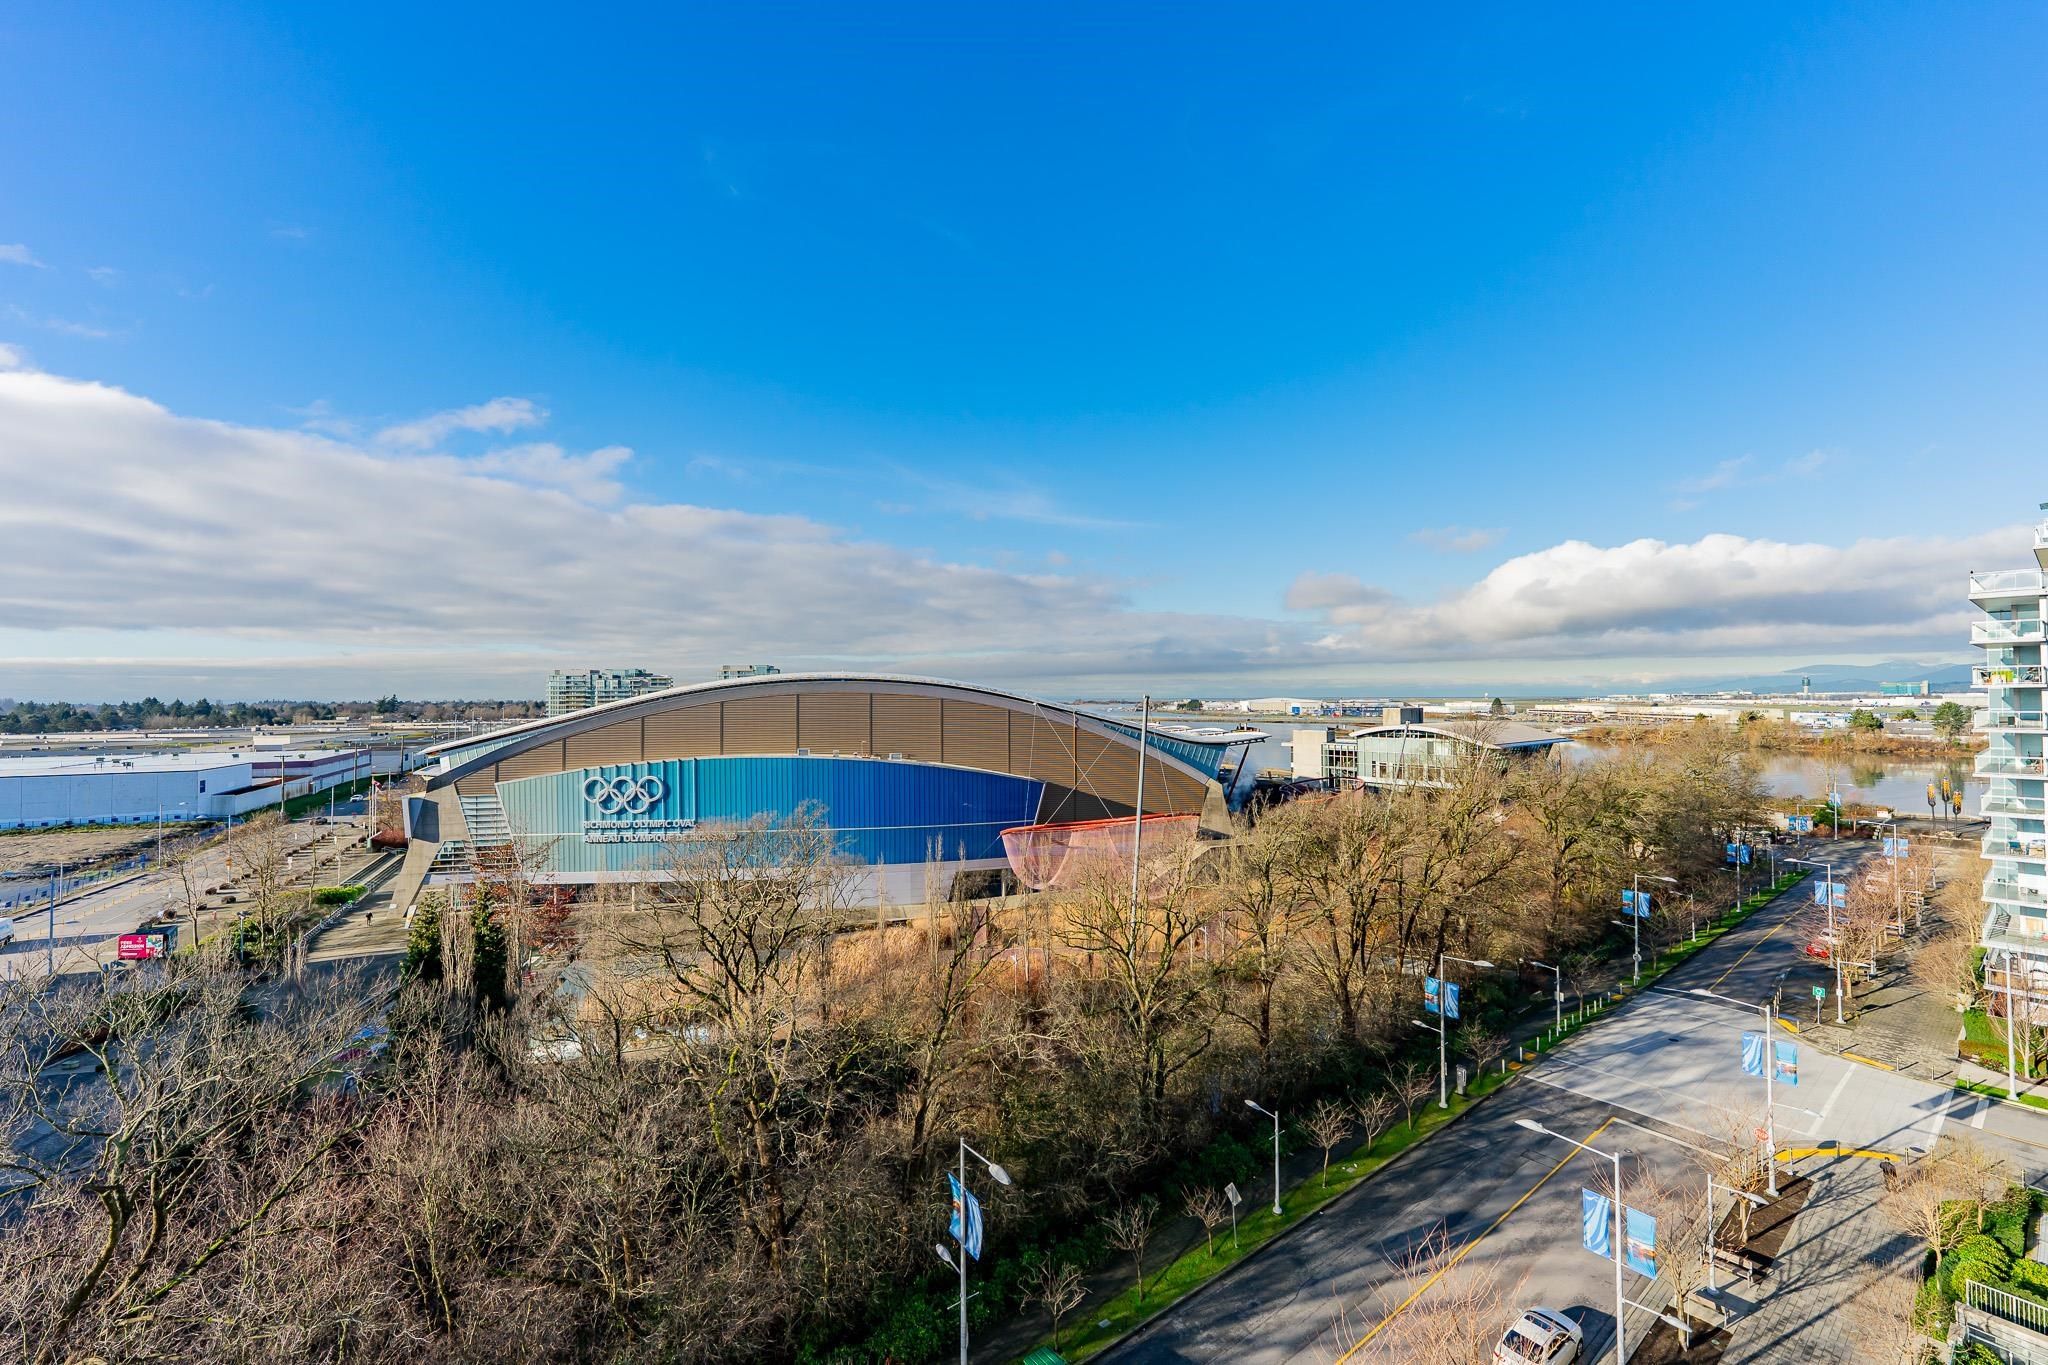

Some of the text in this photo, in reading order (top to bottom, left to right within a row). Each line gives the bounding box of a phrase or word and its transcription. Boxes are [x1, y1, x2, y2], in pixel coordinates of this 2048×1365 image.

[583, 819, 696, 829] RICHMOND OLYMPIC OVAL
[584, 834, 621, 843] ANNEAU
